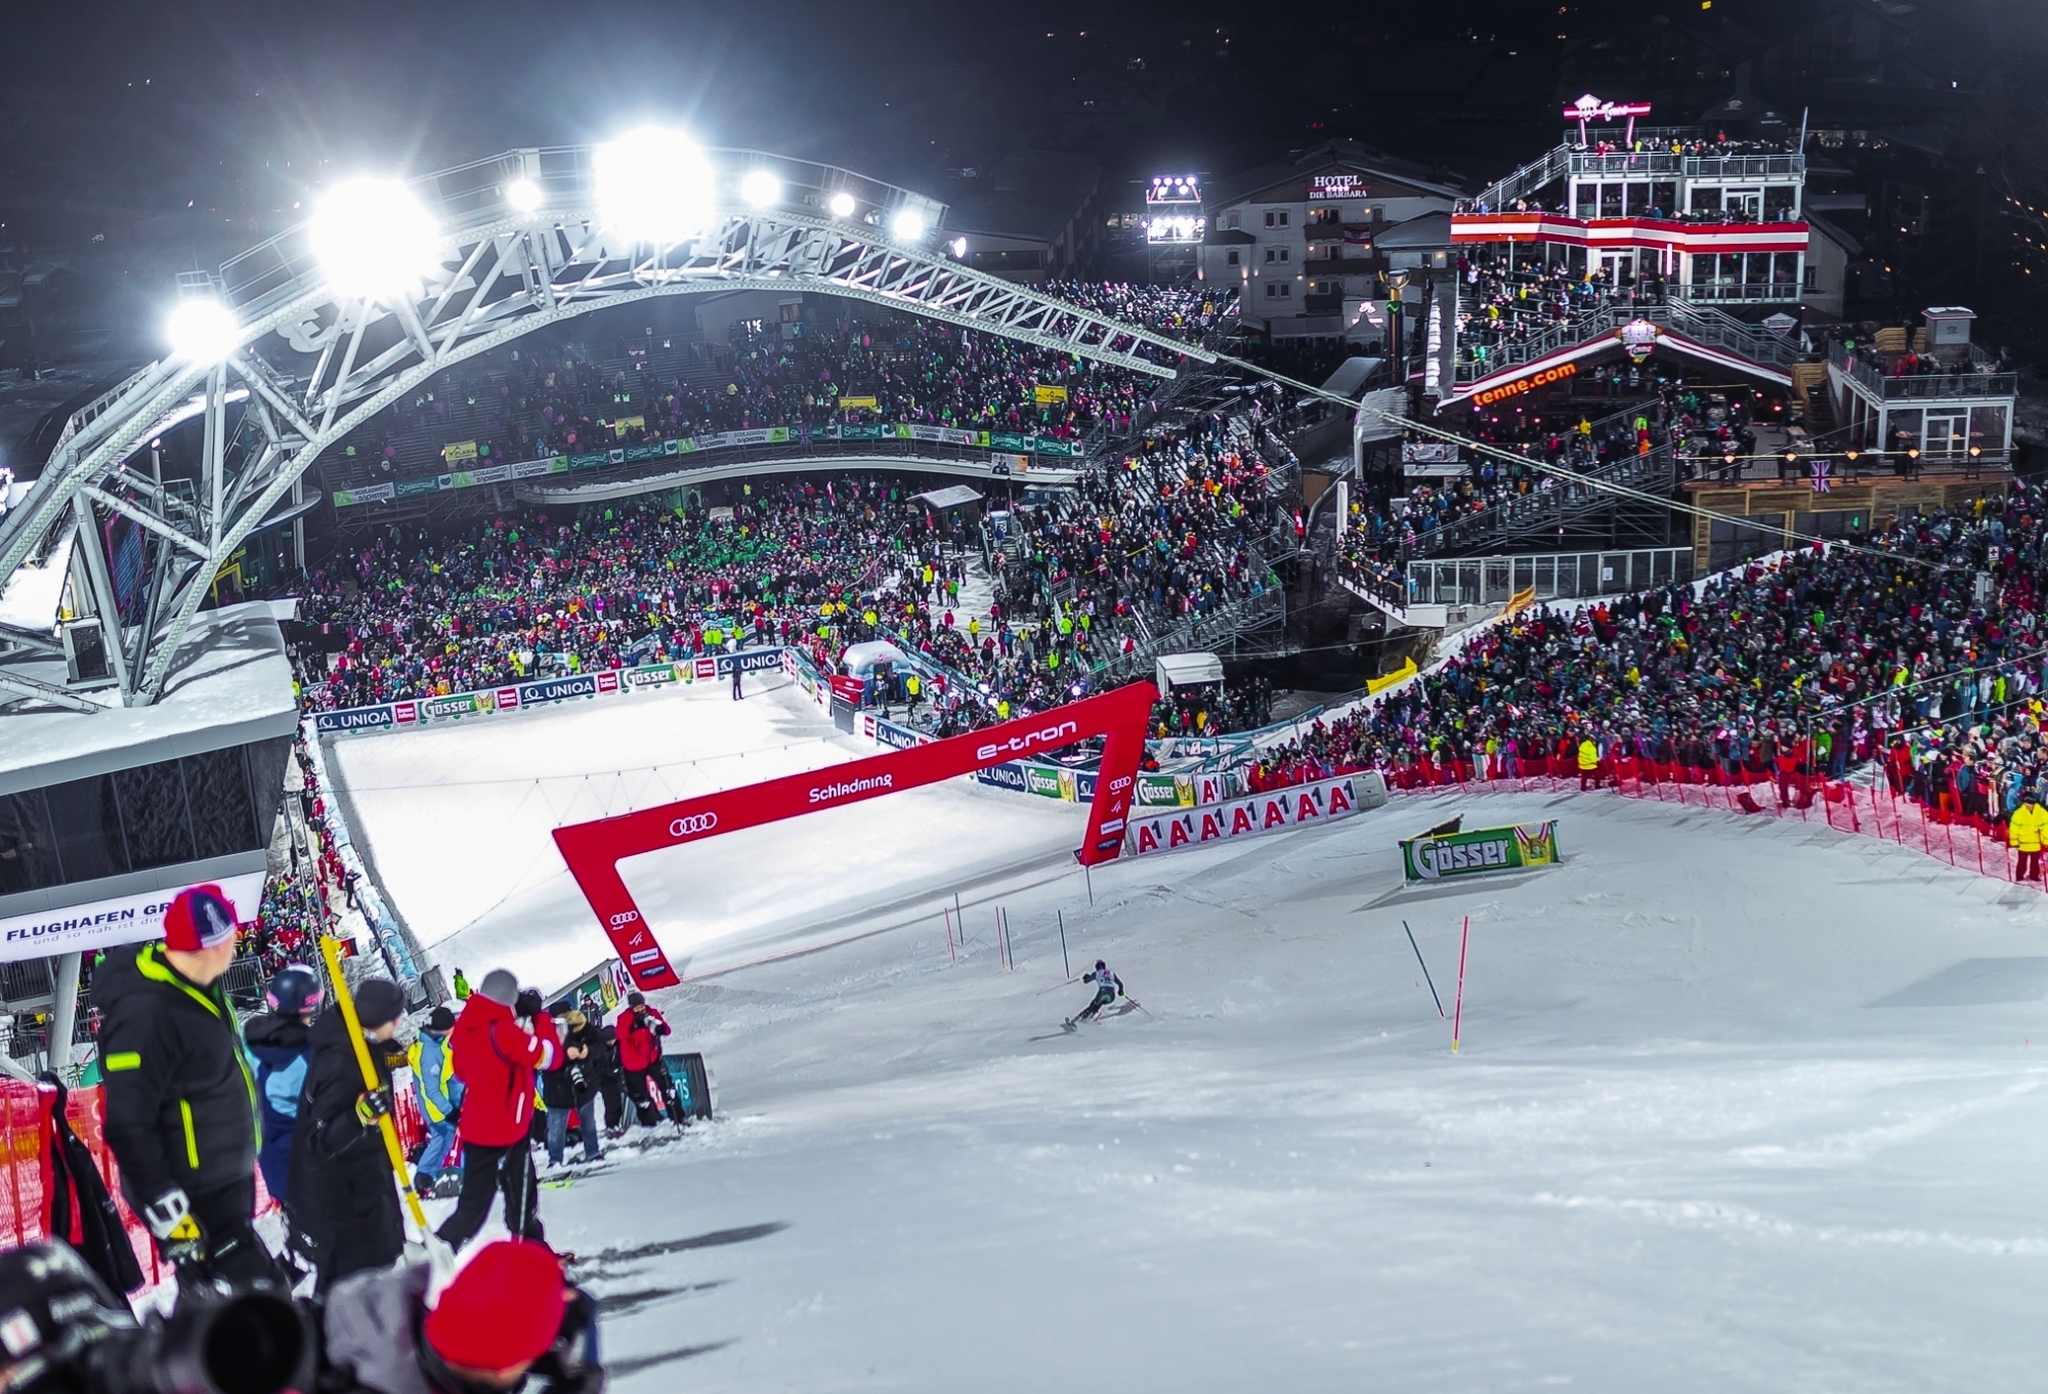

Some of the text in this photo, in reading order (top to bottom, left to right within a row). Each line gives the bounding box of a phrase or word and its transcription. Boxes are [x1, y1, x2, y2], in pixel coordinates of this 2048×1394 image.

[1314, 175, 1363, 187] HOTEL
[1309, 190, 1367, 199] DIE BARBARA
[1472, 362, 1577, 407] tenne.com
[740, 654, 784, 670] UNIQA
[545, 680, 594, 698] UNIQA
[623, 667, 672, 687] Gösser
[340, 711, 391, 728] UNIQA
[421, 700, 473, 719] Gösser
[889, 734, 917, 750] UNIQA
[976, 720, 1078, 761] e-tron
[808, 773, 893, 804] Schladming
[991, 764, 1025, 788] UNIQA
[1029, 766, 1059, 793] Gösser
[1138, 778, 1175, 803] Gösser
[1202, 777, 1219, 804] A1
[1139, 780, 1356, 854] A1 A1 A1 A1 A1 A1 A1
[1411, 838, 1510, 880] Gösser
[6, 901, 174, 942] FLUGHAFEN GR
[33, 915, 161, 946] und so nah ist die
